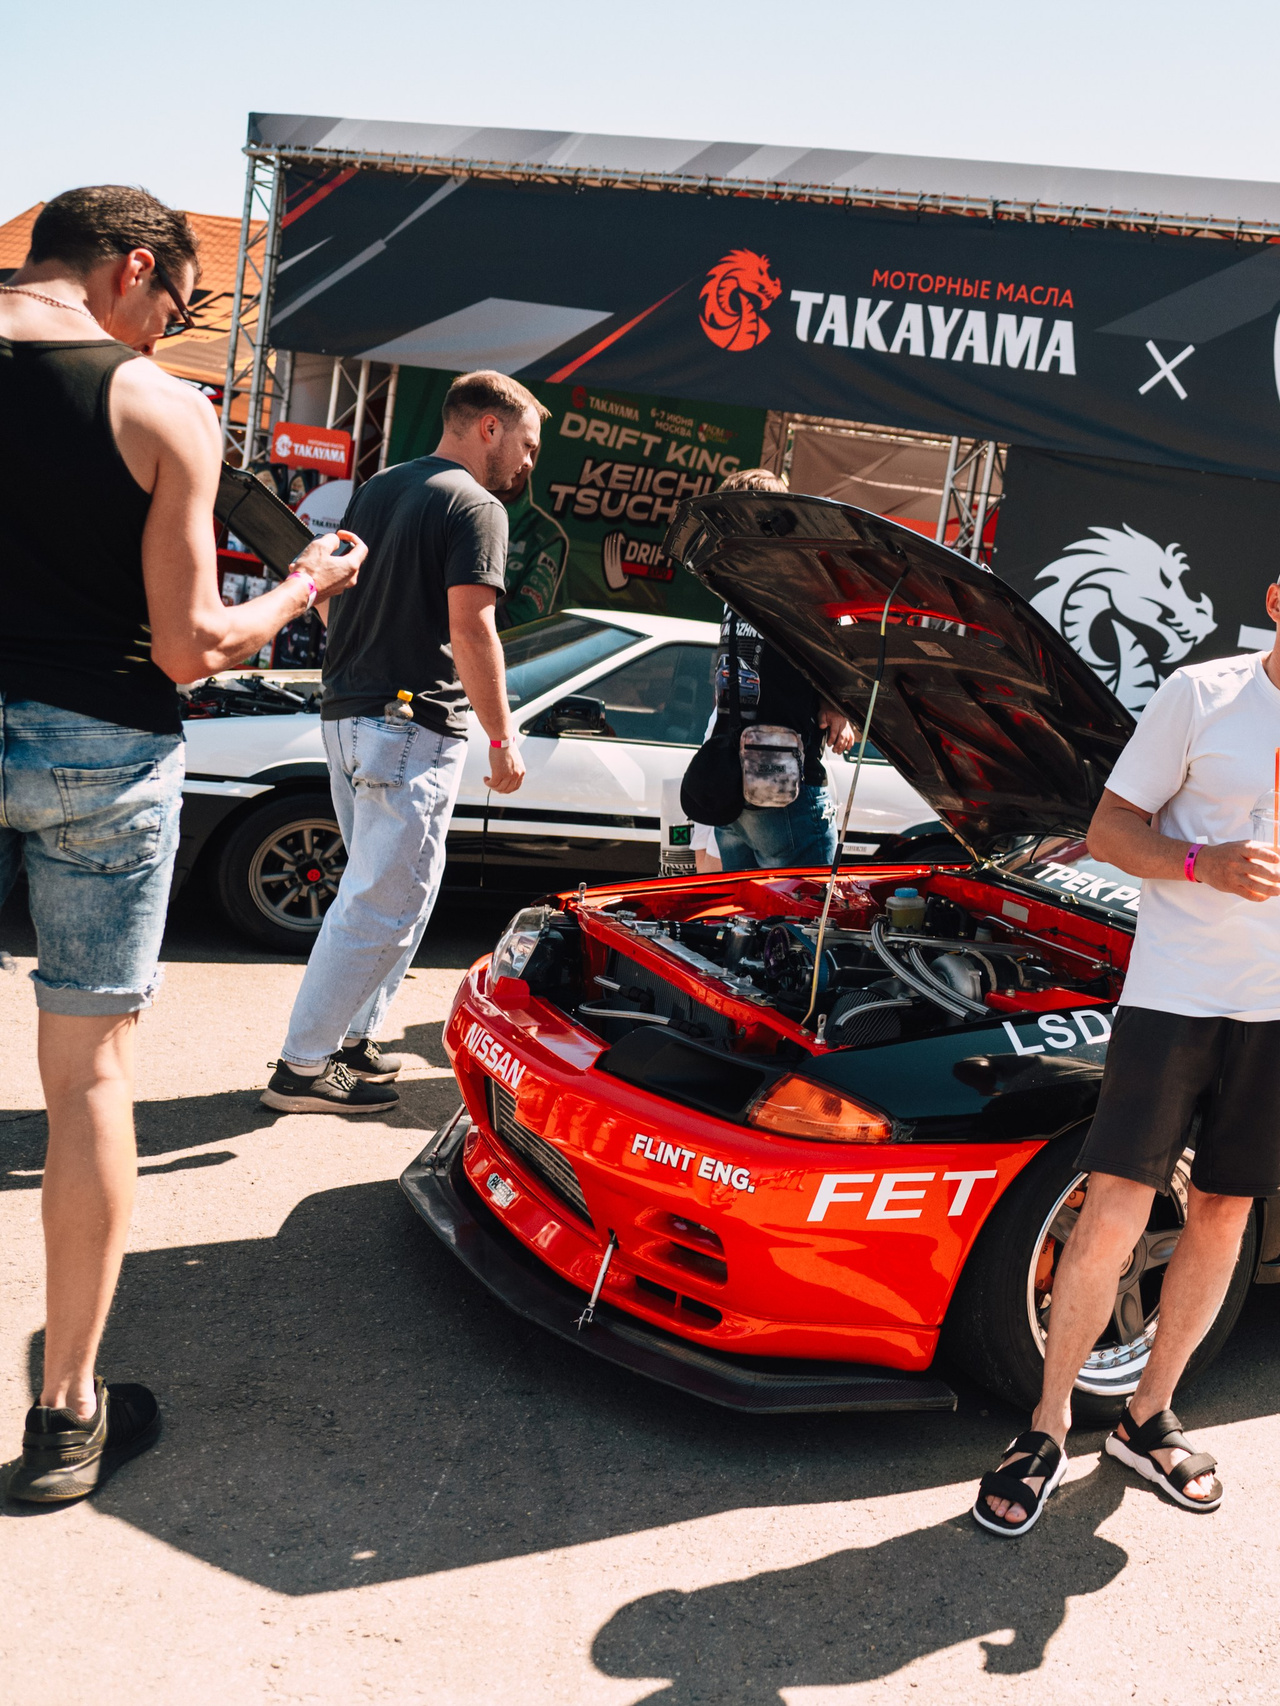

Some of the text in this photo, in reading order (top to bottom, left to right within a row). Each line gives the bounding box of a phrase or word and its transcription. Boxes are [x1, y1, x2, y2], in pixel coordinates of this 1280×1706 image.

[872, 268, 1074, 308] МОТОРНЫЕ МАСЛА
[790, 289, 1077, 376] TAKAYAMA
[589, 396, 640, 422] TAKAYAMA
[654, 420, 692, 438] МОСКВА
[293, 443, 346, 464] TAKAYAMA
[559, 411, 741, 477] DRIFT KING
[579, 459, 713, 498] KEIICHI
[550, 483, 680, 525] TSUCH
[1034, 861, 1118, 899] ТРЕК
[1001, 1006, 1119, 1056] LSD
[463, 1021, 527, 1090] NISSAN
[631, 1132, 756, 1194] FLINT ENG.
[806, 1169, 998, 1222] FET
